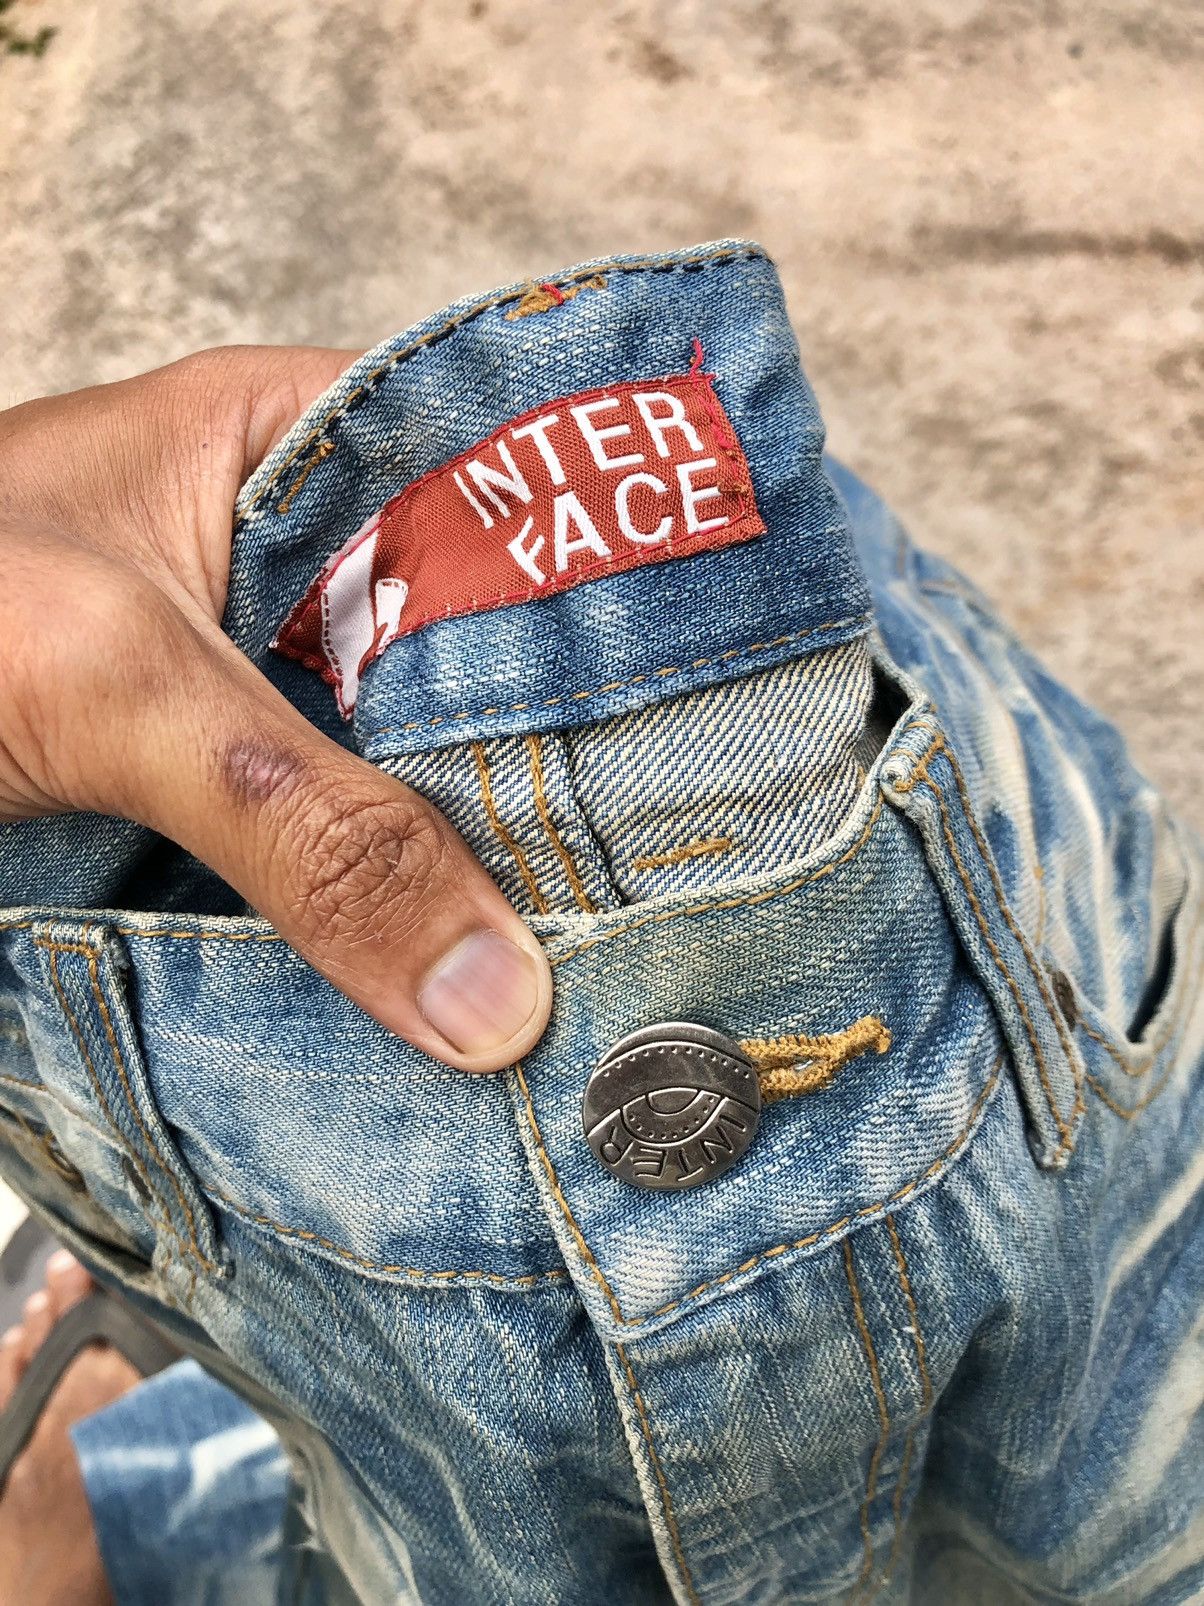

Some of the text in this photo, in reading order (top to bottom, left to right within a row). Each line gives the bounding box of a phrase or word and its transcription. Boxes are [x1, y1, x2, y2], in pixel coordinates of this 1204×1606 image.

[452, 391, 704, 529] INTER
[506, 458, 729, 585] FACE
[600, 1114, 747, 1182] INTER
